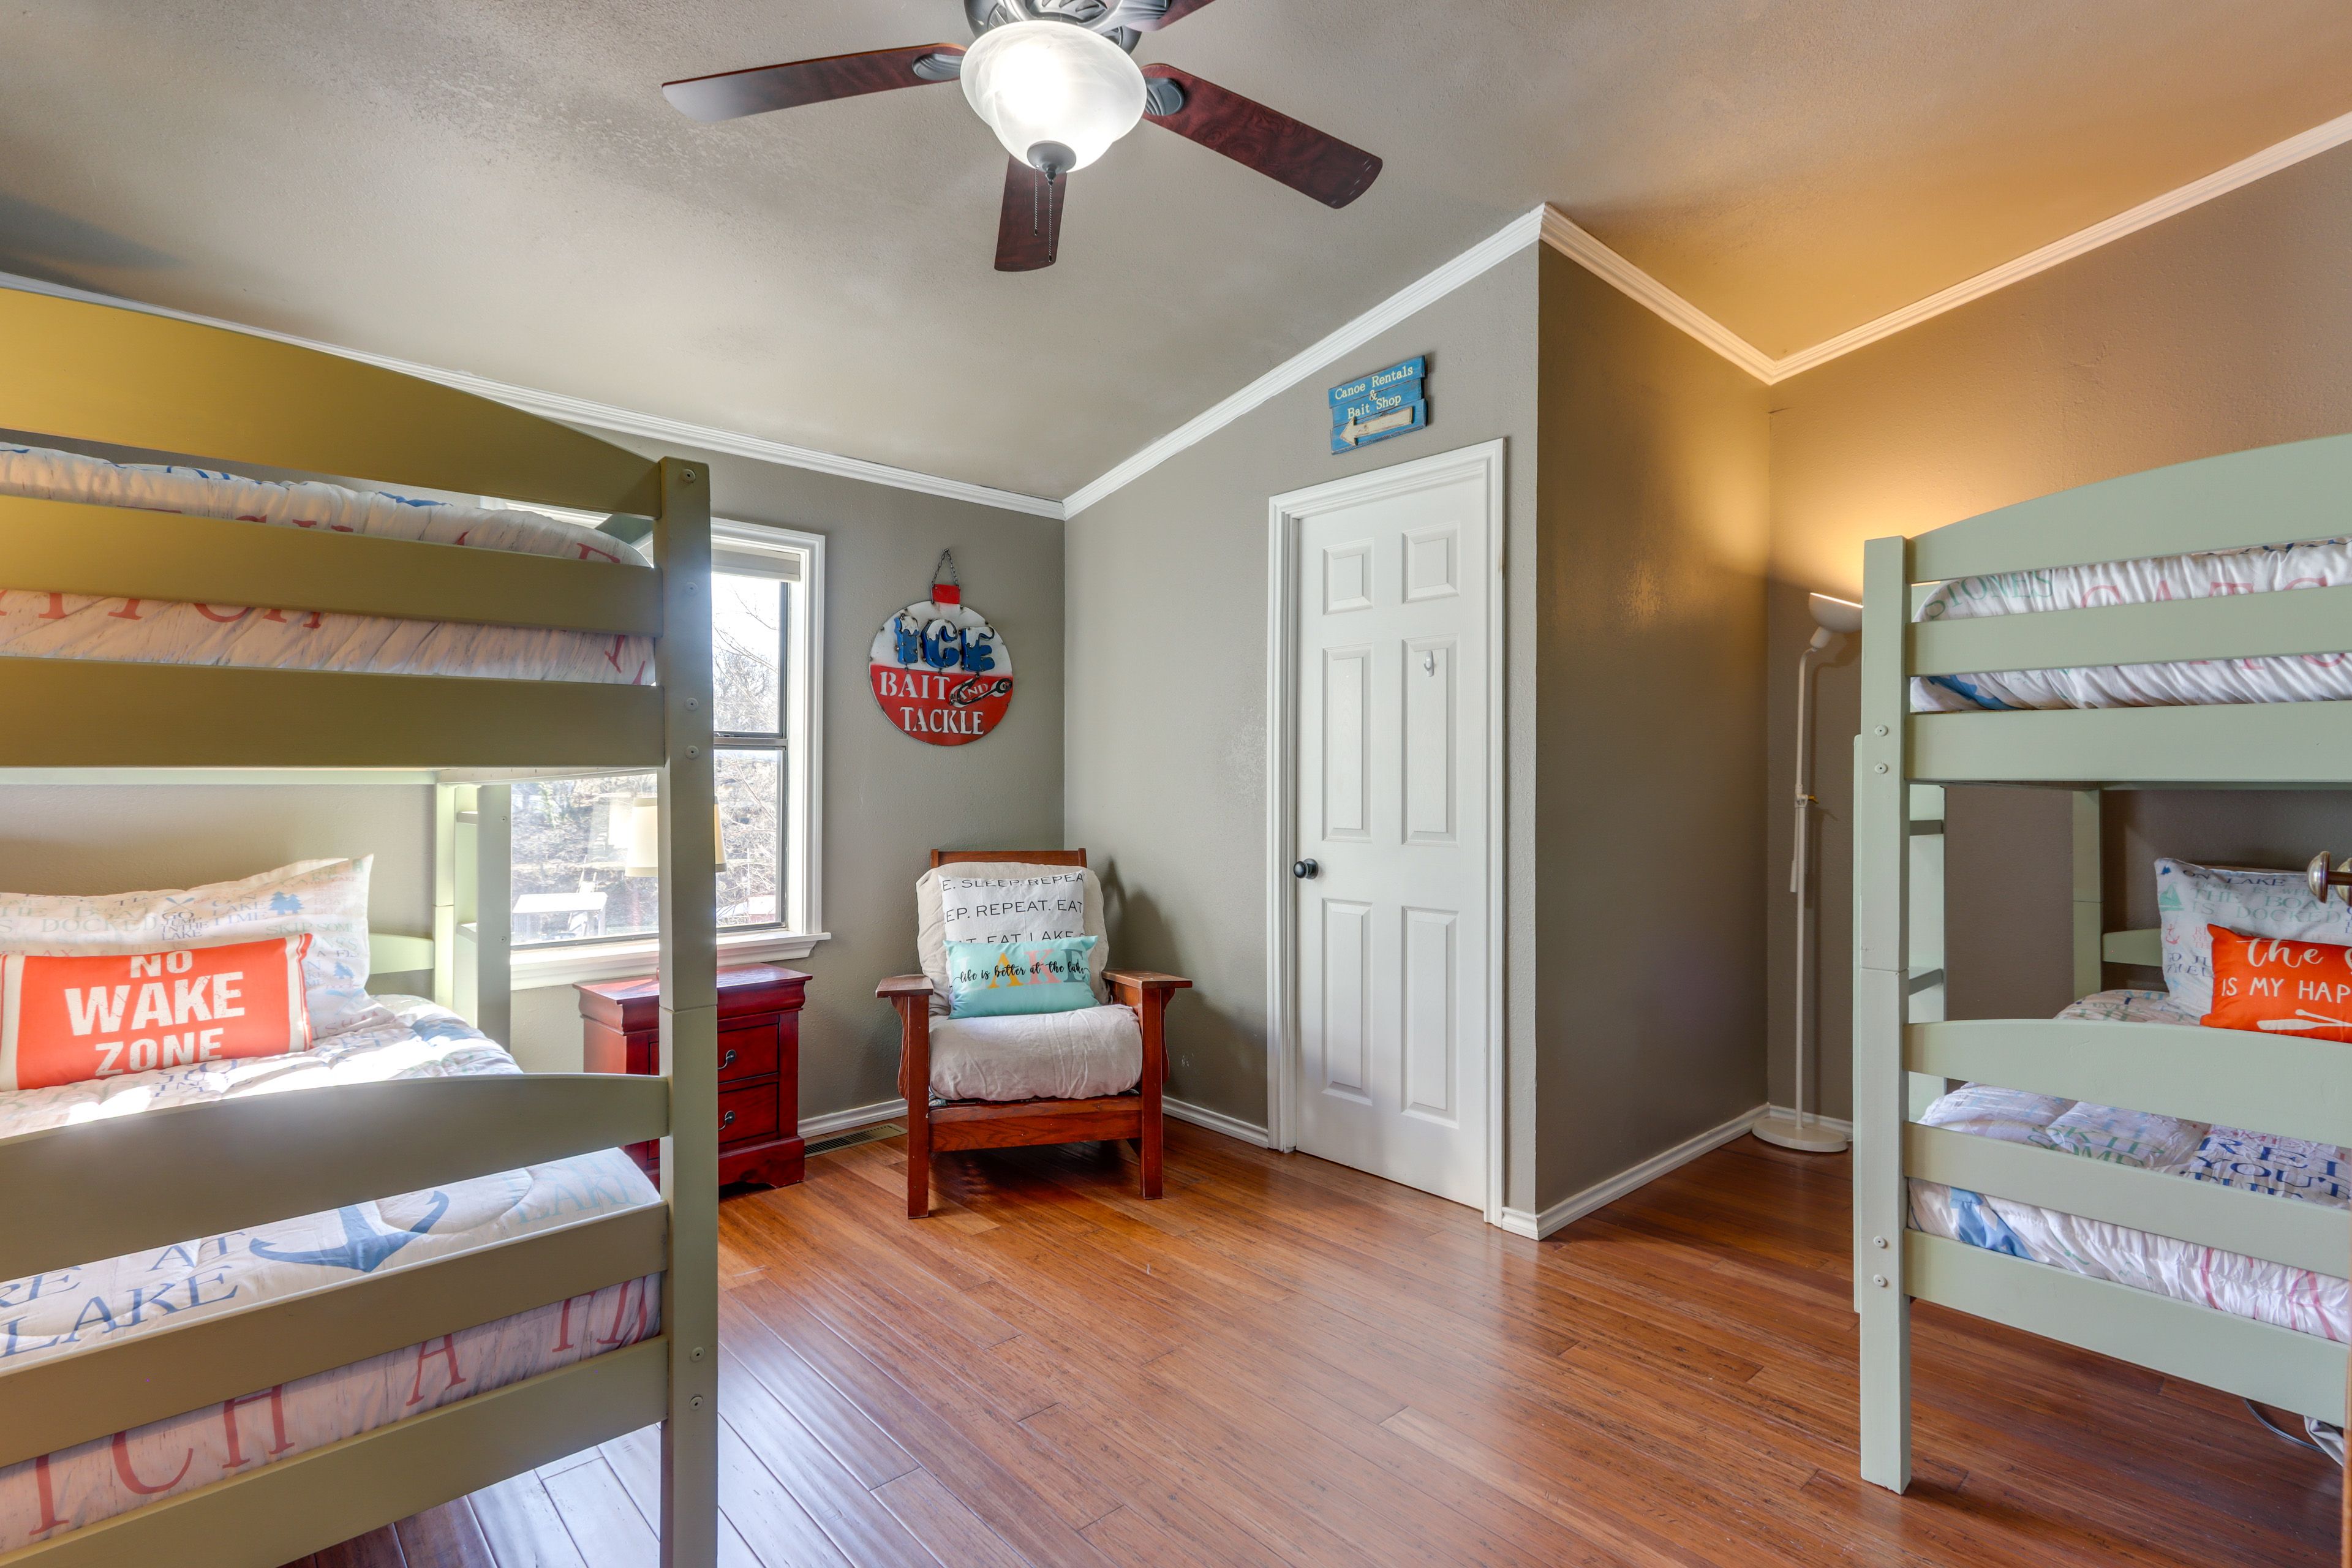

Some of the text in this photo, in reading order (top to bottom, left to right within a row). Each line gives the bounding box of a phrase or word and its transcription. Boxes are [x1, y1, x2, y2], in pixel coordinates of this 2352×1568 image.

[1335, 366, 1413, 399] Canoe Rentals
[1370, 390, 1378, 401] &
[1348, 395, 1401, 419] Bait Shop
[894, 615, 995, 672] ICE
[880, 671, 950, 700] BAIT
[900, 707, 984, 735] TACKLE
[1028, 873, 1085, 886] REPEA
[2226, 878, 2286, 887] LAKE
[162, 911, 195, 920] GO
[976, 900, 1051, 918] REPEAT.
[2236, 905, 2342, 924] DOCKED
[162, 930, 203, 941] LAKE
[130, 951, 193, 978] NO
[952, 969, 977, 984] life
[981, 970, 990, 980] is
[994, 964, 1026, 978] better
[1030, 961, 1044, 974] at
[1045, 961, 1065, 973] the
[65, 971, 245, 1036] WAKE
[2222, 977, 2351, 1004] IS MY HAP
[94, 1027, 225, 1076] ZONE
[145, 1232, 246, 1272] AT
[0, 1265, 238, 1358] LAKE
